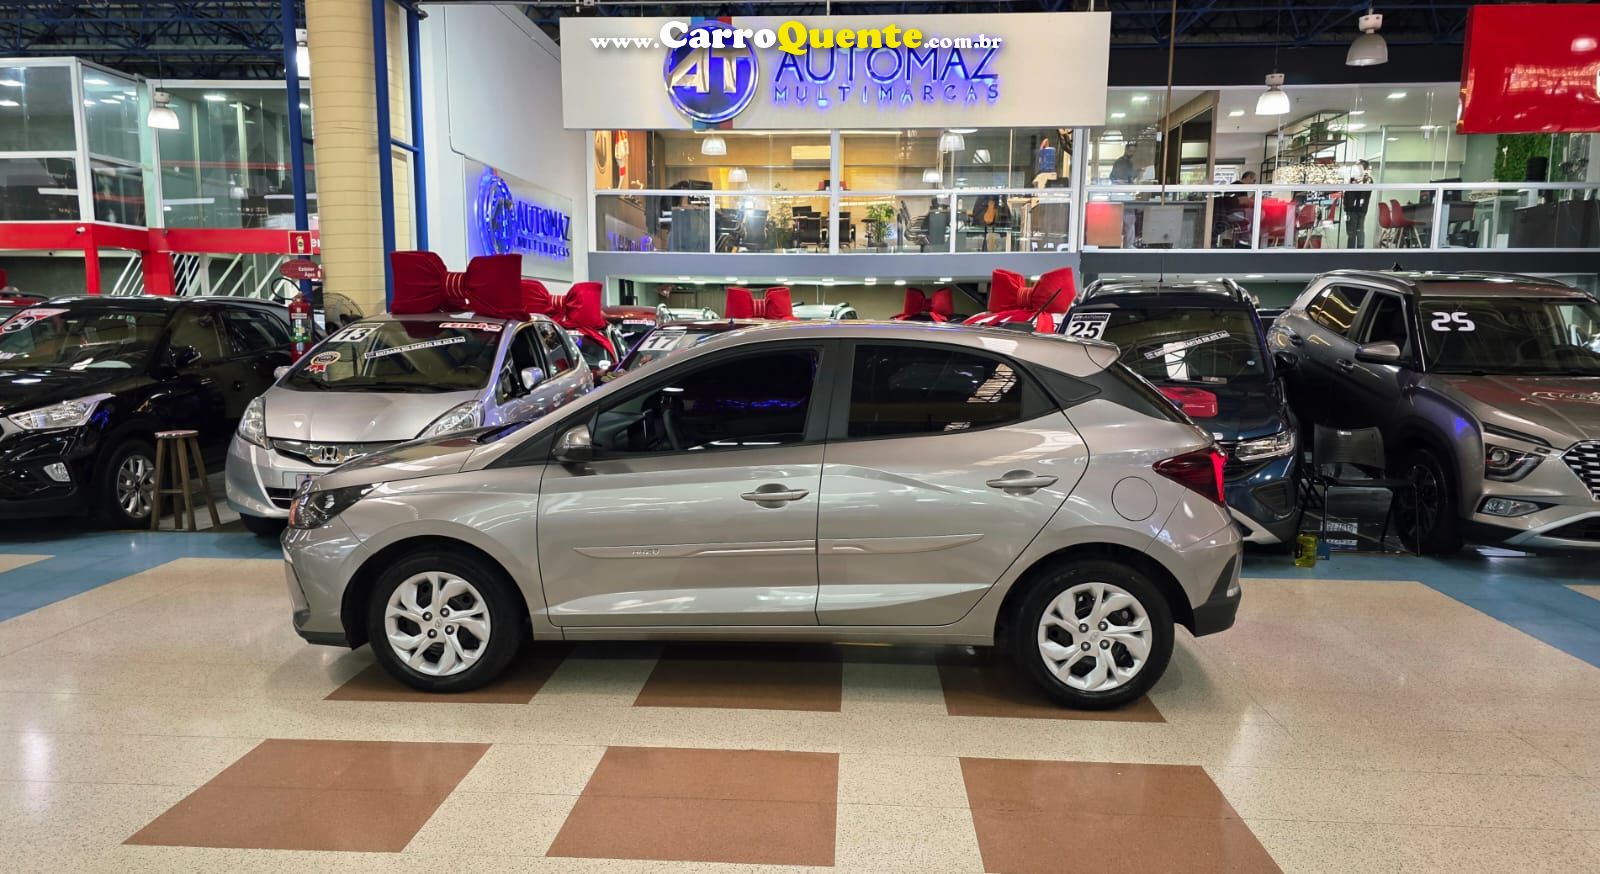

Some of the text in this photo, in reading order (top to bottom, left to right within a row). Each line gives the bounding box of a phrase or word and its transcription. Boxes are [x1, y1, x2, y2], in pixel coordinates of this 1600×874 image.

[668, 47, 752, 93] AT
[774, 44, 999, 82] AUTOMAZ
[774, 84, 999, 102] MULTIMARCAS
[517, 200, 571, 242] AUTOMAZ
[1071, 321, 1102, 339] 25
[1431, 311, 1476, 332] 25
[339, 328, 369, 341] 13
[648, 336, 676, 349] 17
